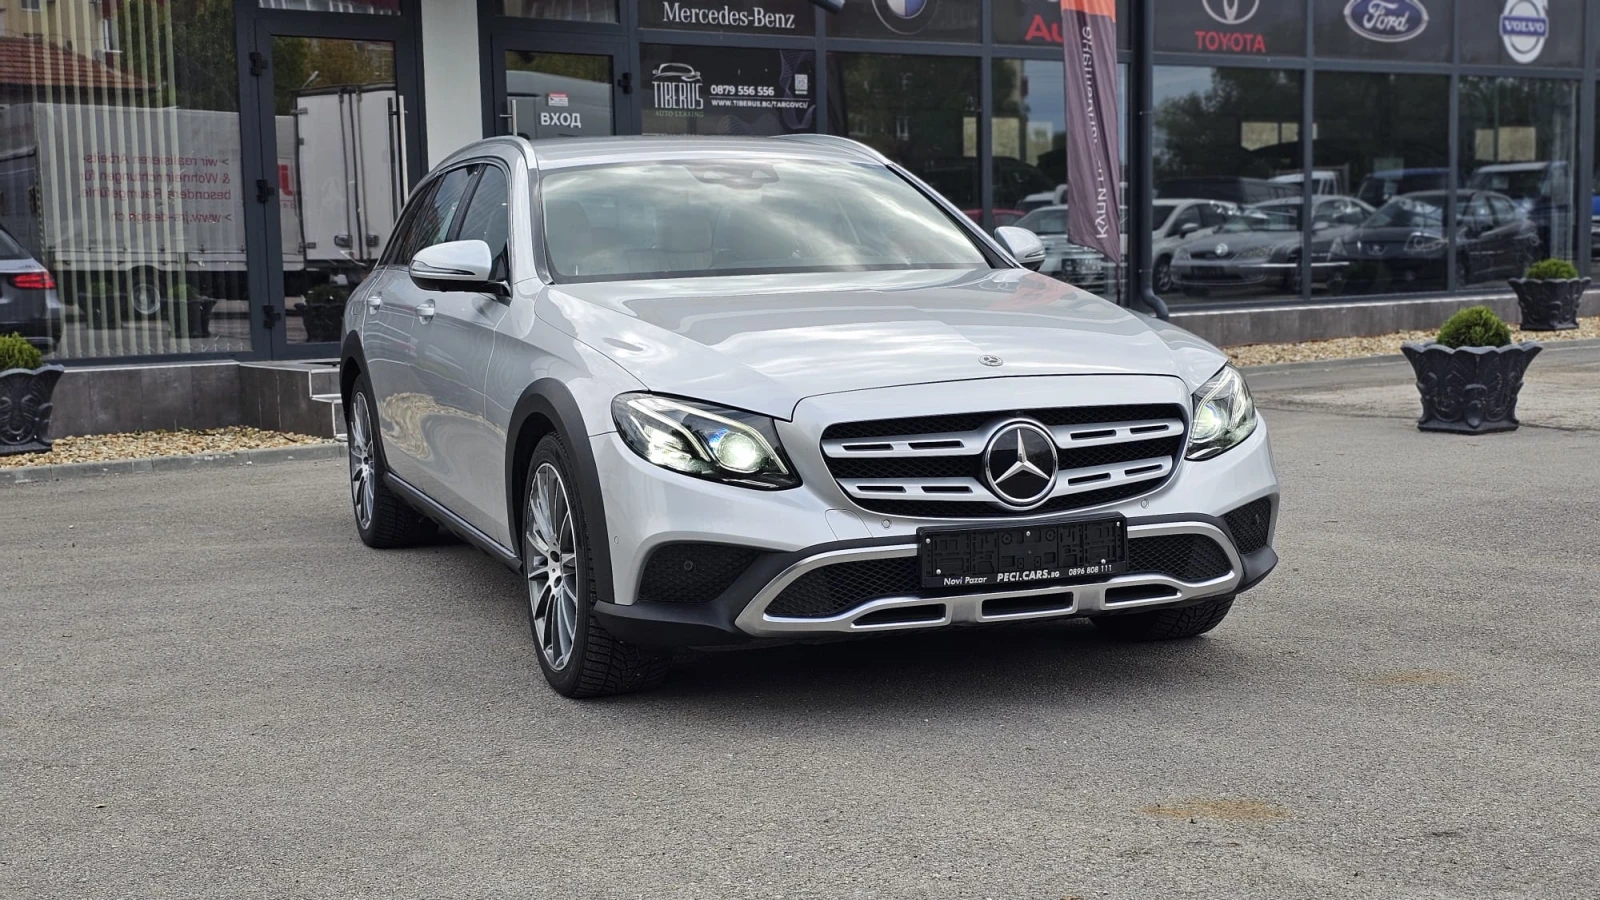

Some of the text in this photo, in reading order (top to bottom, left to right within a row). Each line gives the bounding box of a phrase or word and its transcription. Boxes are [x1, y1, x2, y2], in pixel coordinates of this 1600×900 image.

[663, 2, 795, 29] Mercedes-Benz
[1363, 0, 1409, 31] Ford
[1504, 20, 1545, 32] VOLVO
[1024, 14, 1063, 42] Au
[1195, 31, 1266, 53] TOYOTA
[652, 81, 704, 109] TIBERUS
[710, 85, 775, 96] 0879 556 556
[541, 112, 581, 128] ВХОД
[674, 110, 704, 118] LEASING
[943, 564, 1112, 586] Novi Pazar PECI.CARS.BG 0896 808 111
